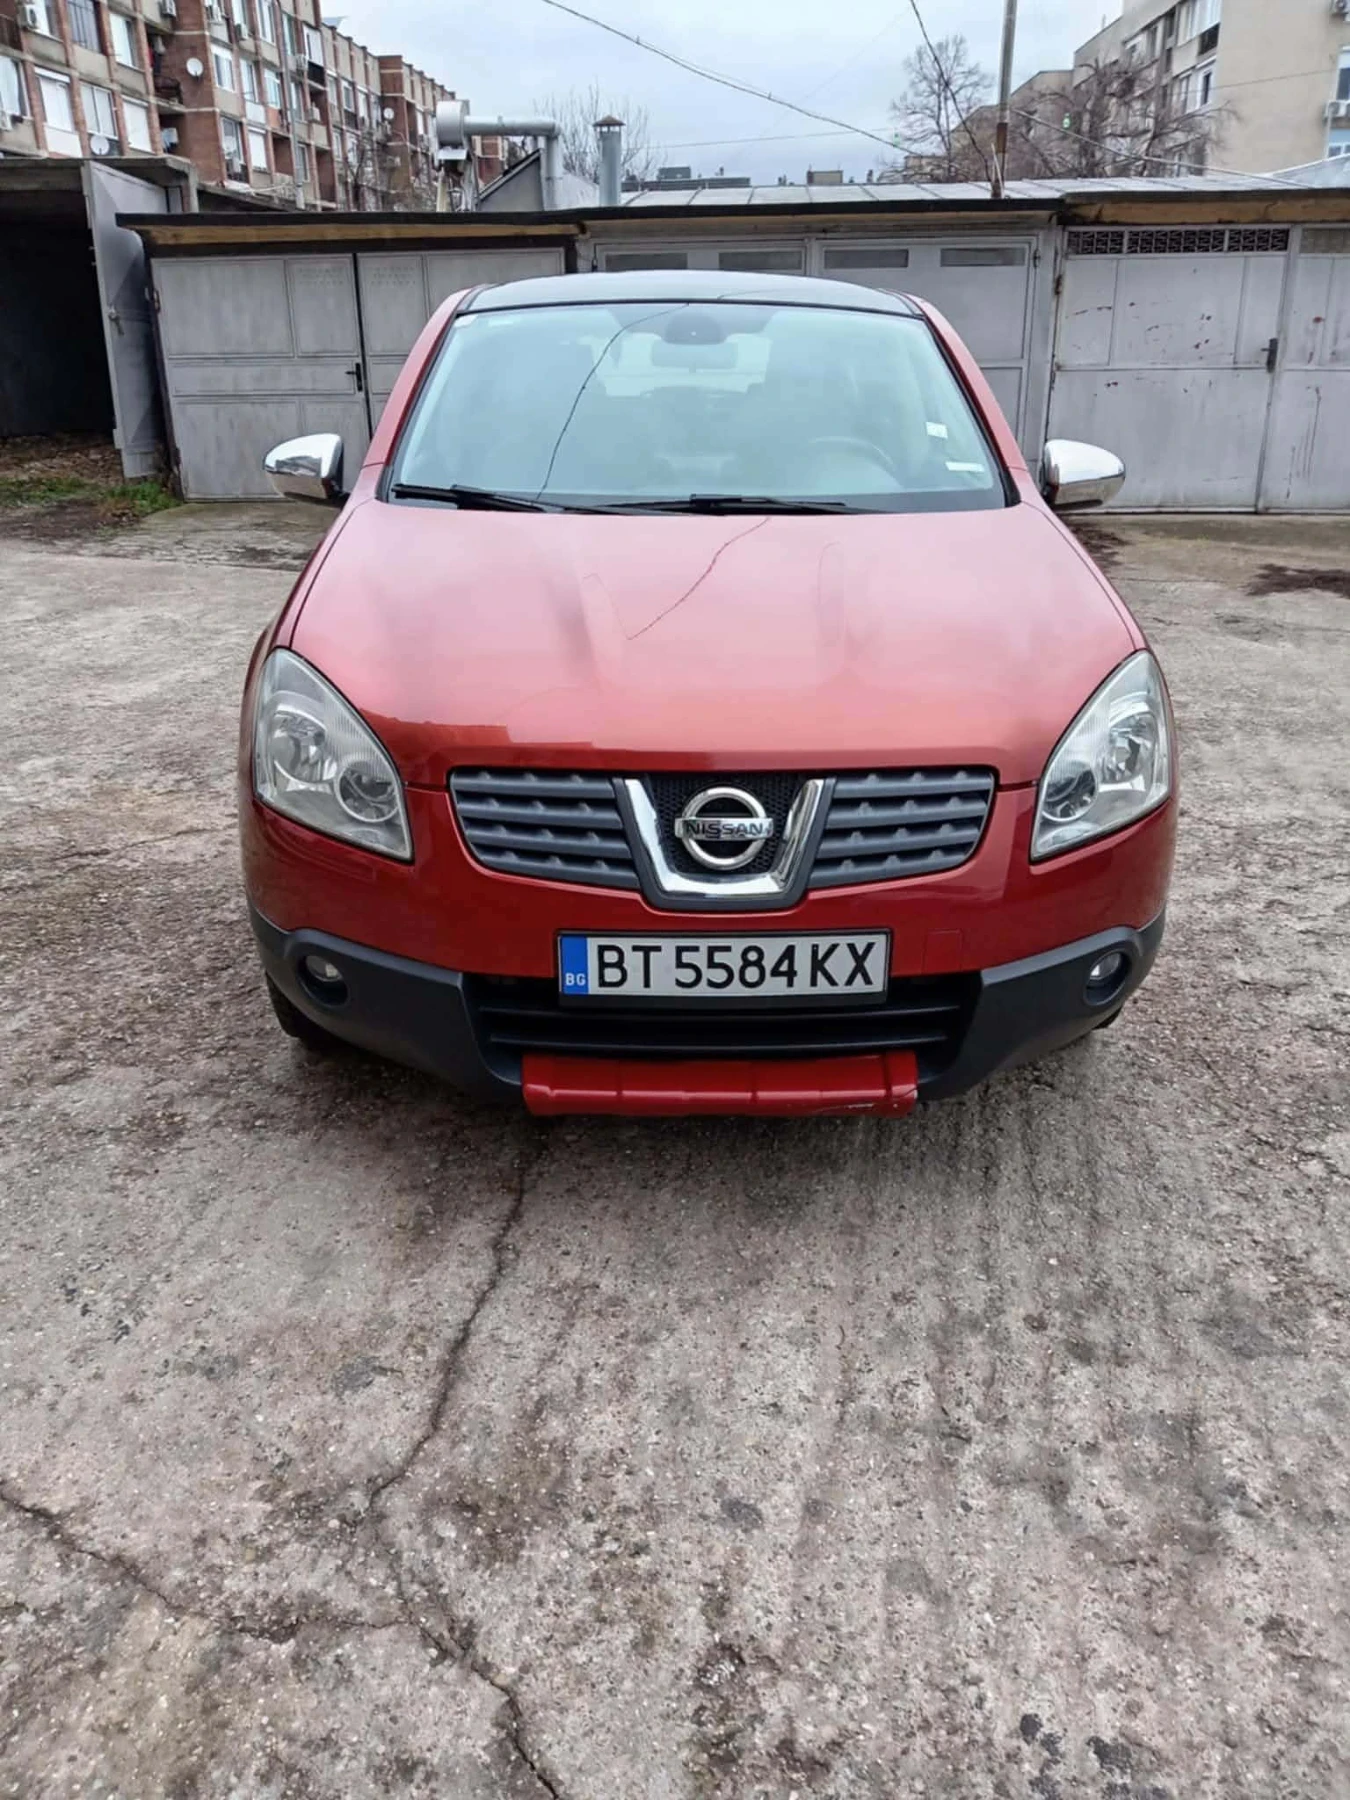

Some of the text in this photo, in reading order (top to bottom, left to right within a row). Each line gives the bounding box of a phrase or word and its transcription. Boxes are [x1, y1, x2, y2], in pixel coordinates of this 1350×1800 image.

[685, 821, 763, 837] NISSAN
[597, 942, 876, 989] BT 5584 KX
[565, 973, 586, 986] BG
